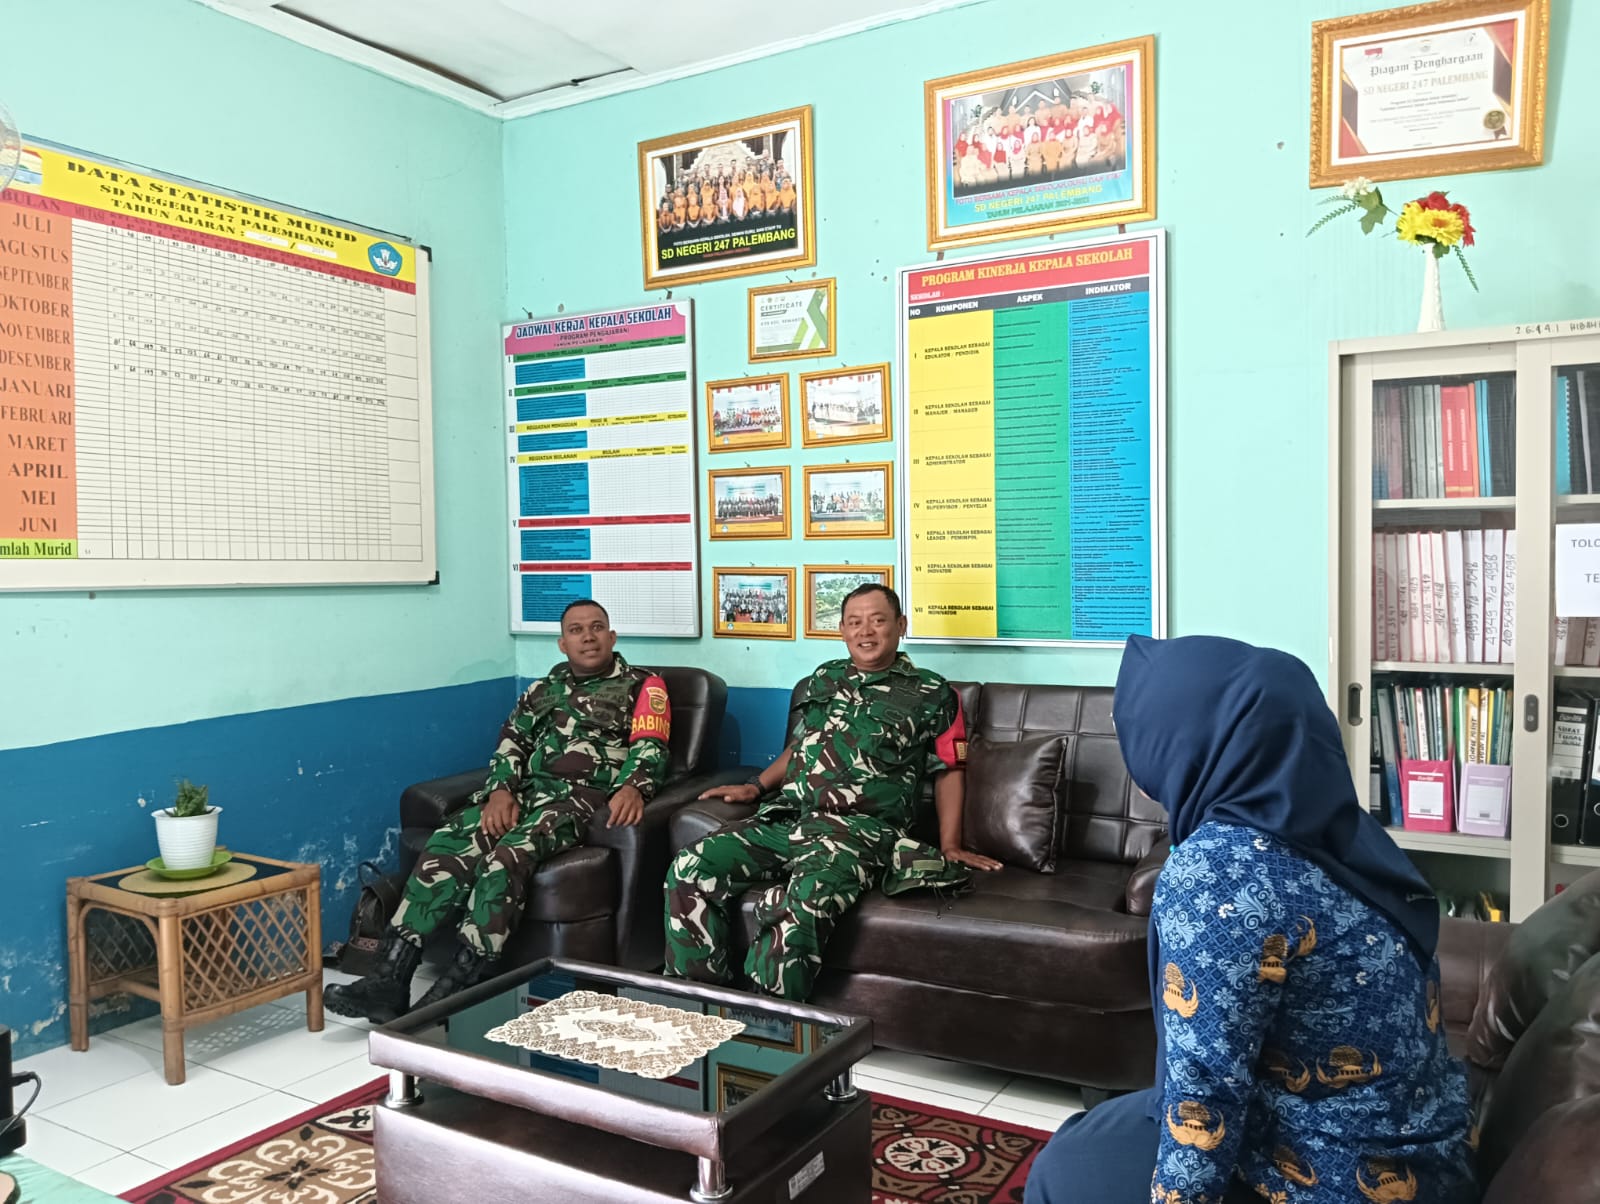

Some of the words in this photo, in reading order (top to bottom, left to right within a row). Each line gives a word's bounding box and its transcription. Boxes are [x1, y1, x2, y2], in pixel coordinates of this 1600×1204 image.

[1414, 52, 1483, 70] Penghargaan
[1377, 81, 1409, 94] NEGERI
[1412, 77, 1429, 90] 247
[1431, 71, 1488, 87] PALEMBANG
[68, 161, 140, 188] DATA
[149, 183, 279, 222] STATISTIK
[287, 217, 357, 243] MURID
[12, 212, 51, 234] JULI
[100, 184, 125, 197] SD
[132, 192, 199, 215] NEGERI
[205, 210, 235, 223] 247
[241, 219, 335, 248] PALEMBANG
[111, 198, 170, 219] TAHUN
[176, 214, 236, 235] AJARAN
[661, 247, 674, 260] SD
[676, 241, 712, 258] NEGERI
[714, 238, 730, 252] 247
[732, 227, 796, 249] PALEMBANG
[922, 269, 975, 288] PROGRAM
[977, 263, 1026, 281] KINERJA
[1028, 256, 1073, 274] KEPALA
[1075, 248, 1133, 267] SEKOLAH
[910, 308, 921, 317] NO
[936, 301, 979, 313] KOMPONEN
[1016, 294, 1043, 304] ASPEK
[1085, 282, 1132, 295] INDIKATOR
[516, 322, 553, 338] JADWAL
[555, 319, 585, 334] KERJA
[589, 313, 625, 328] KEPALA
[628, 307, 672, 324] SEKOLAH
[0, 377, 71, 399] JANUARI
[1, 405, 72, 426] FEBRUARI
[8, 433, 68, 452] MARET
[8, 462, 69, 479] APRIL
[21, 490, 56, 505] MEI
[19, 517, 57, 532] JUNI
[33, 542, 72, 556] Murid
